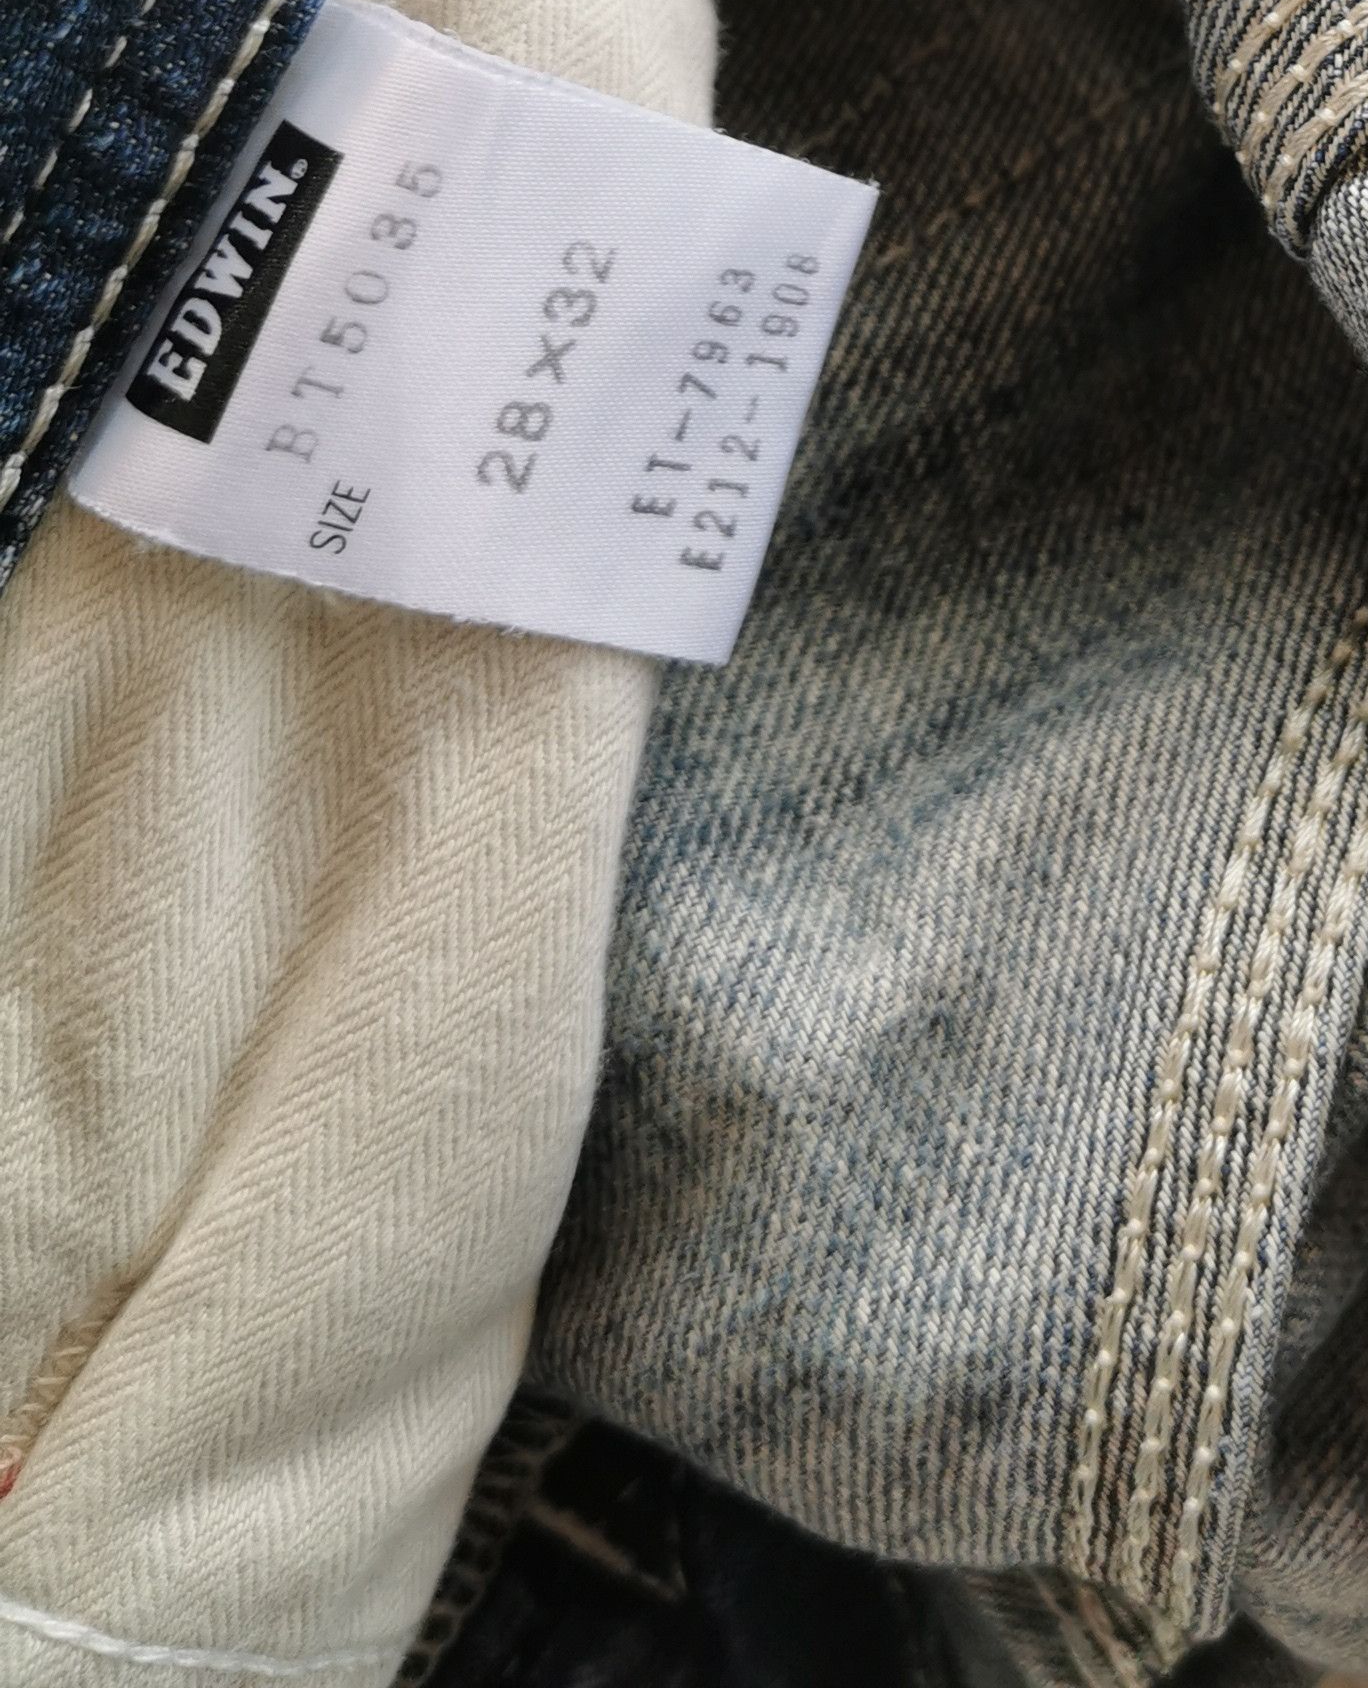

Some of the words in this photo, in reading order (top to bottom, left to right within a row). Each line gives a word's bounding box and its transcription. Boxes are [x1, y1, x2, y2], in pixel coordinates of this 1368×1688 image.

[264, 160, 443, 464] BT5035
[628, 266, 756, 520] ET-7963
[308, 479, 371, 555] SIZE
